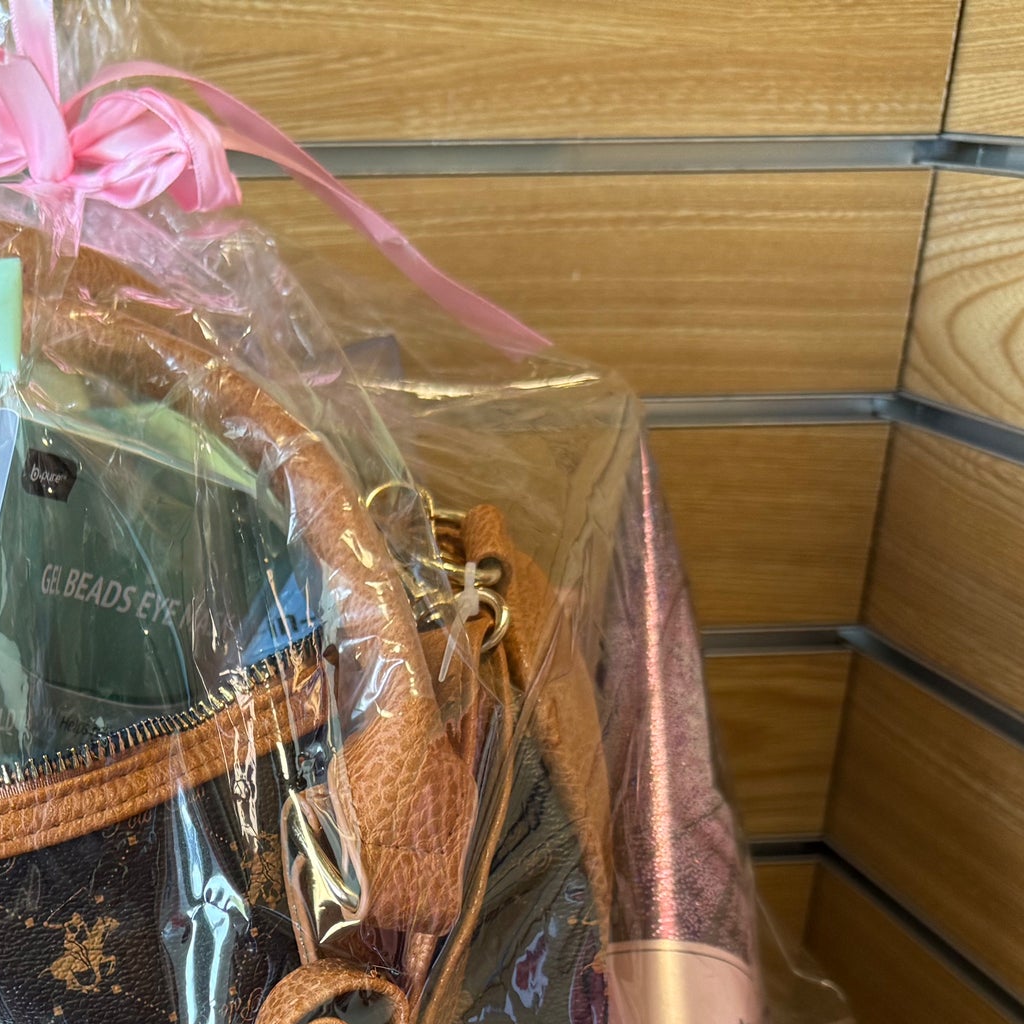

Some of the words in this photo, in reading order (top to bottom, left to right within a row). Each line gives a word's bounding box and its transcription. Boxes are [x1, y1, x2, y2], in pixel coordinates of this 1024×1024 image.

[41, 562, 64, 596] GEL
[63, 567, 137, 614] BEADS
[135, 590, 180, 627] EYE
